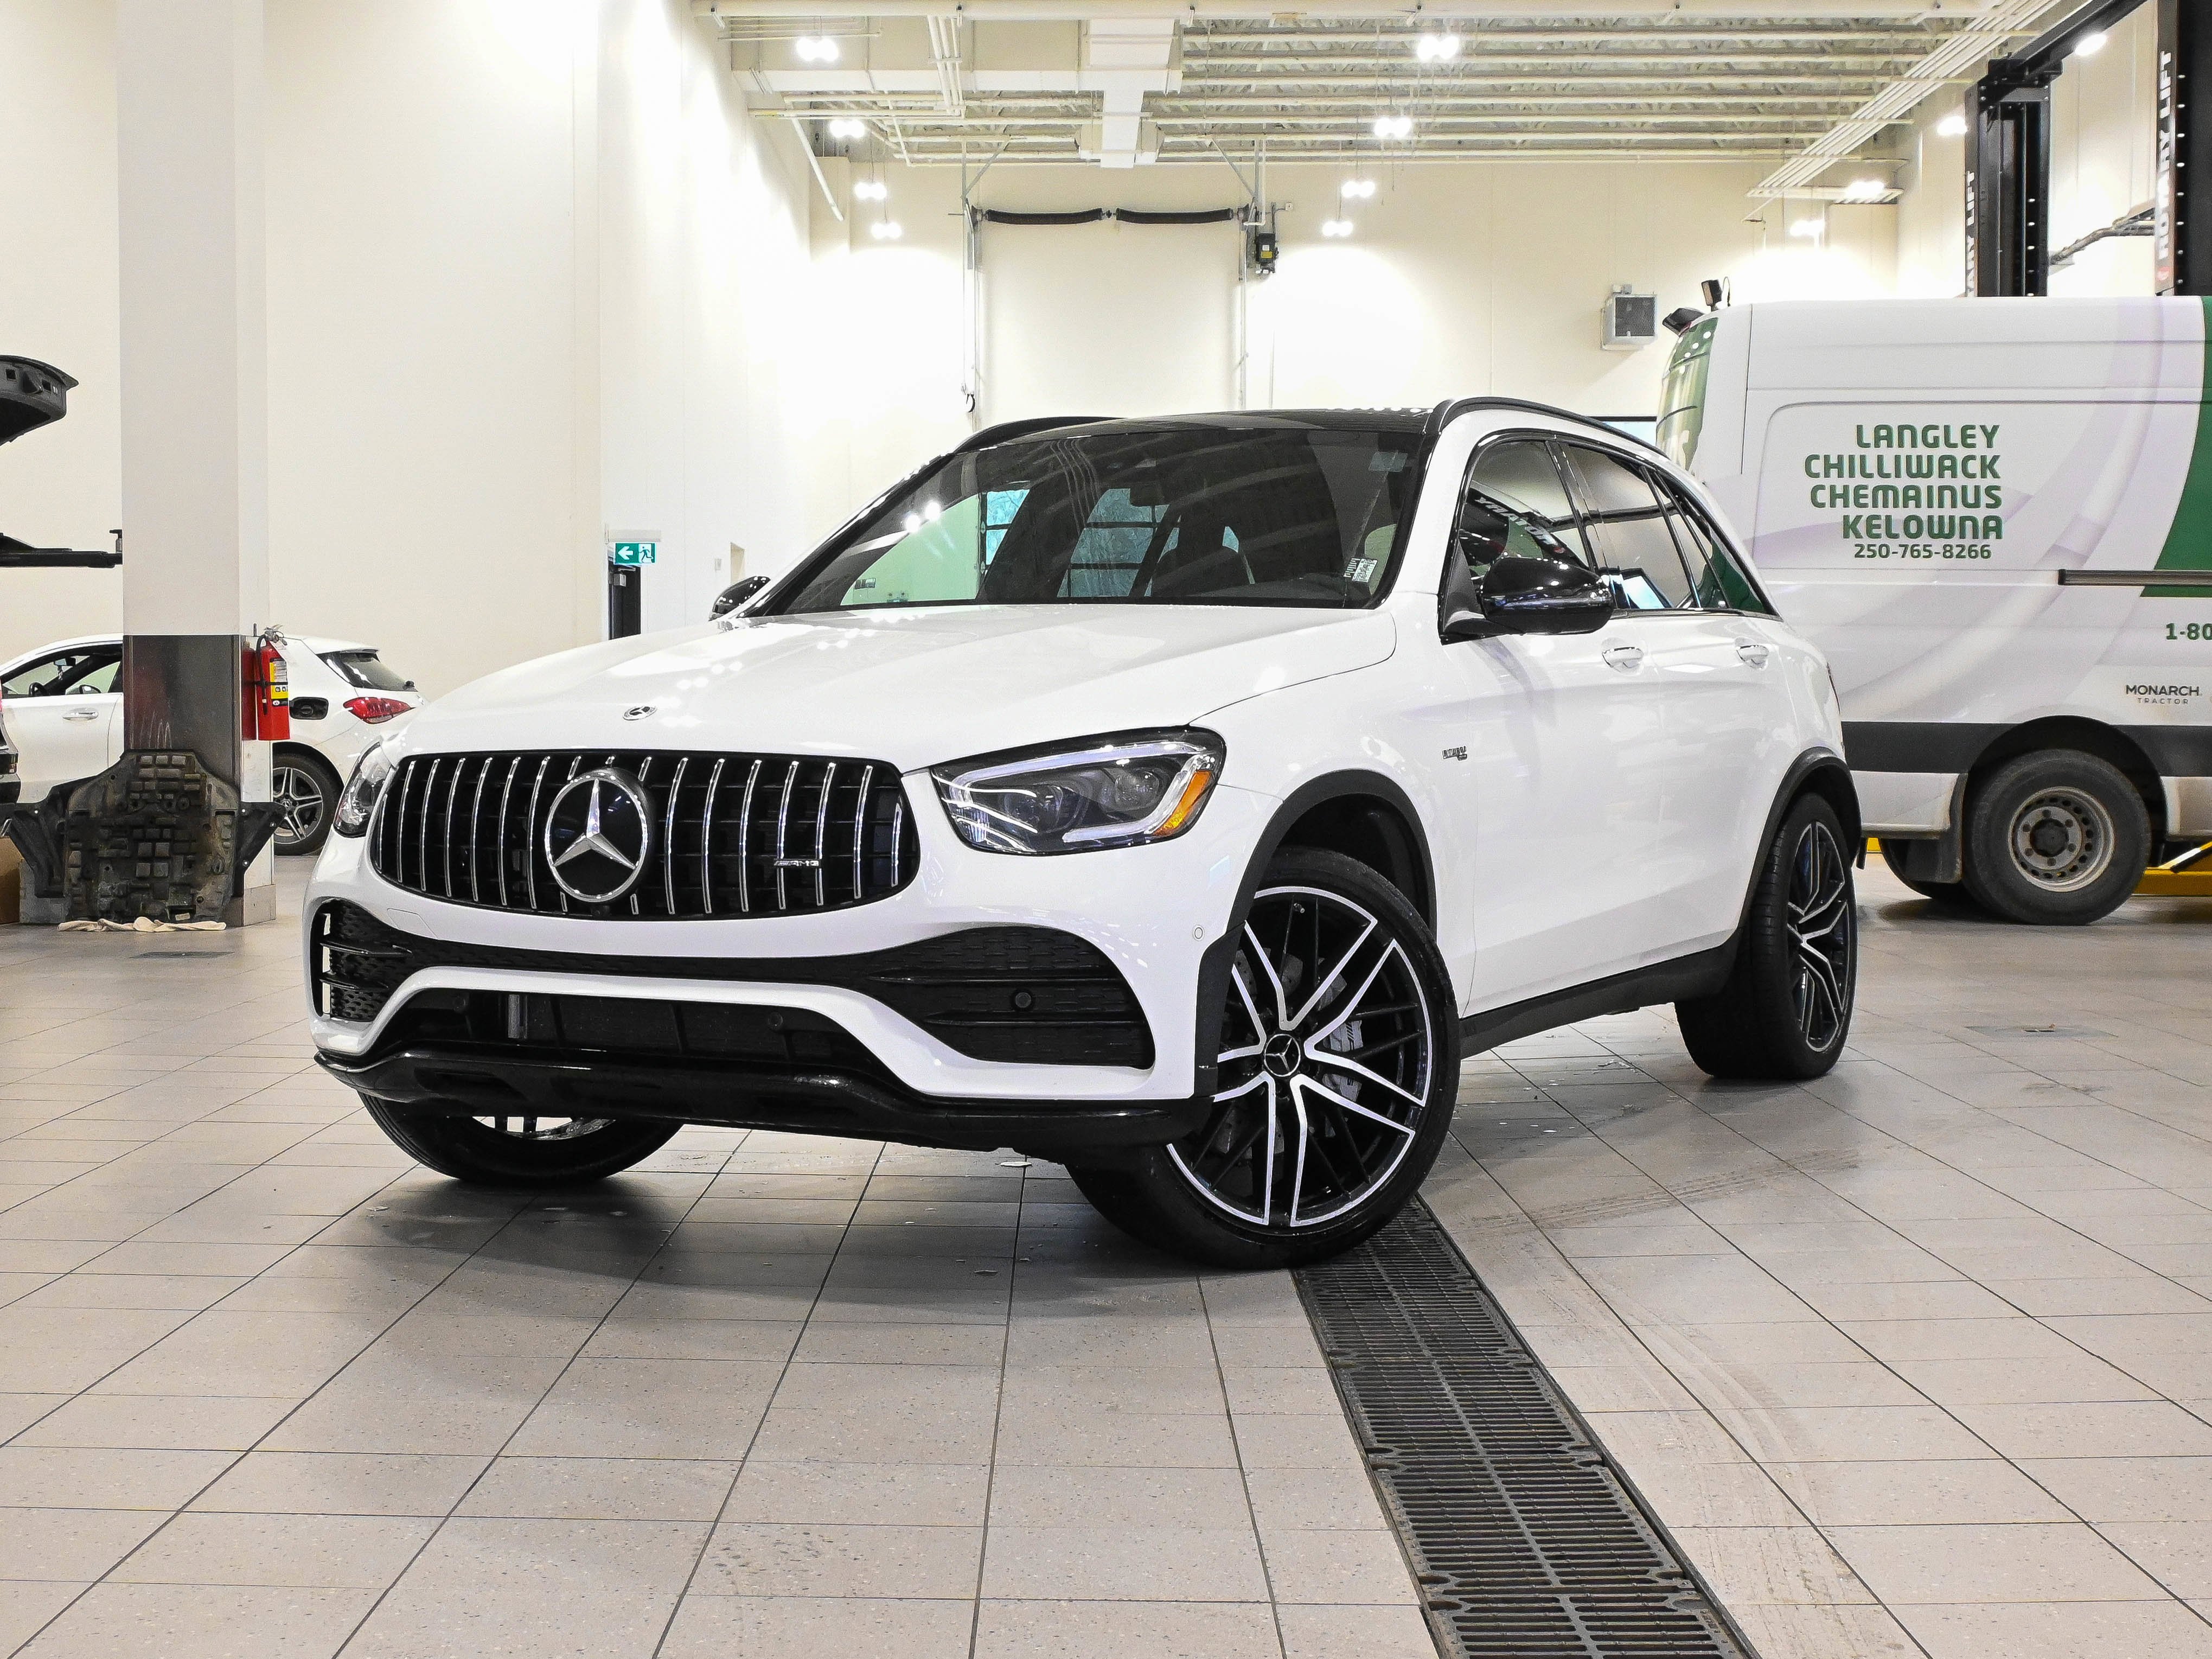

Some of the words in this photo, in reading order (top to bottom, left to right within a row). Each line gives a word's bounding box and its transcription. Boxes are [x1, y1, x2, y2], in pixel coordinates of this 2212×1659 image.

[2159, 51, 2171, 119] LIFT
[1966, 171, 1975, 226] LIFT
[1966, 235, 1975, 297] TARY
[1856, 424, 2000, 448] LANGLEY
[1805, 454, 2001, 478] CHILLIWACK
[1811, 484, 2003, 509] CHEMAINUS
[1843, 514, 2003, 540] KELOWNA
[1854, 543, 1992, 559] 250-765-8266
[2126, 685, 2200, 696] MONARCH
